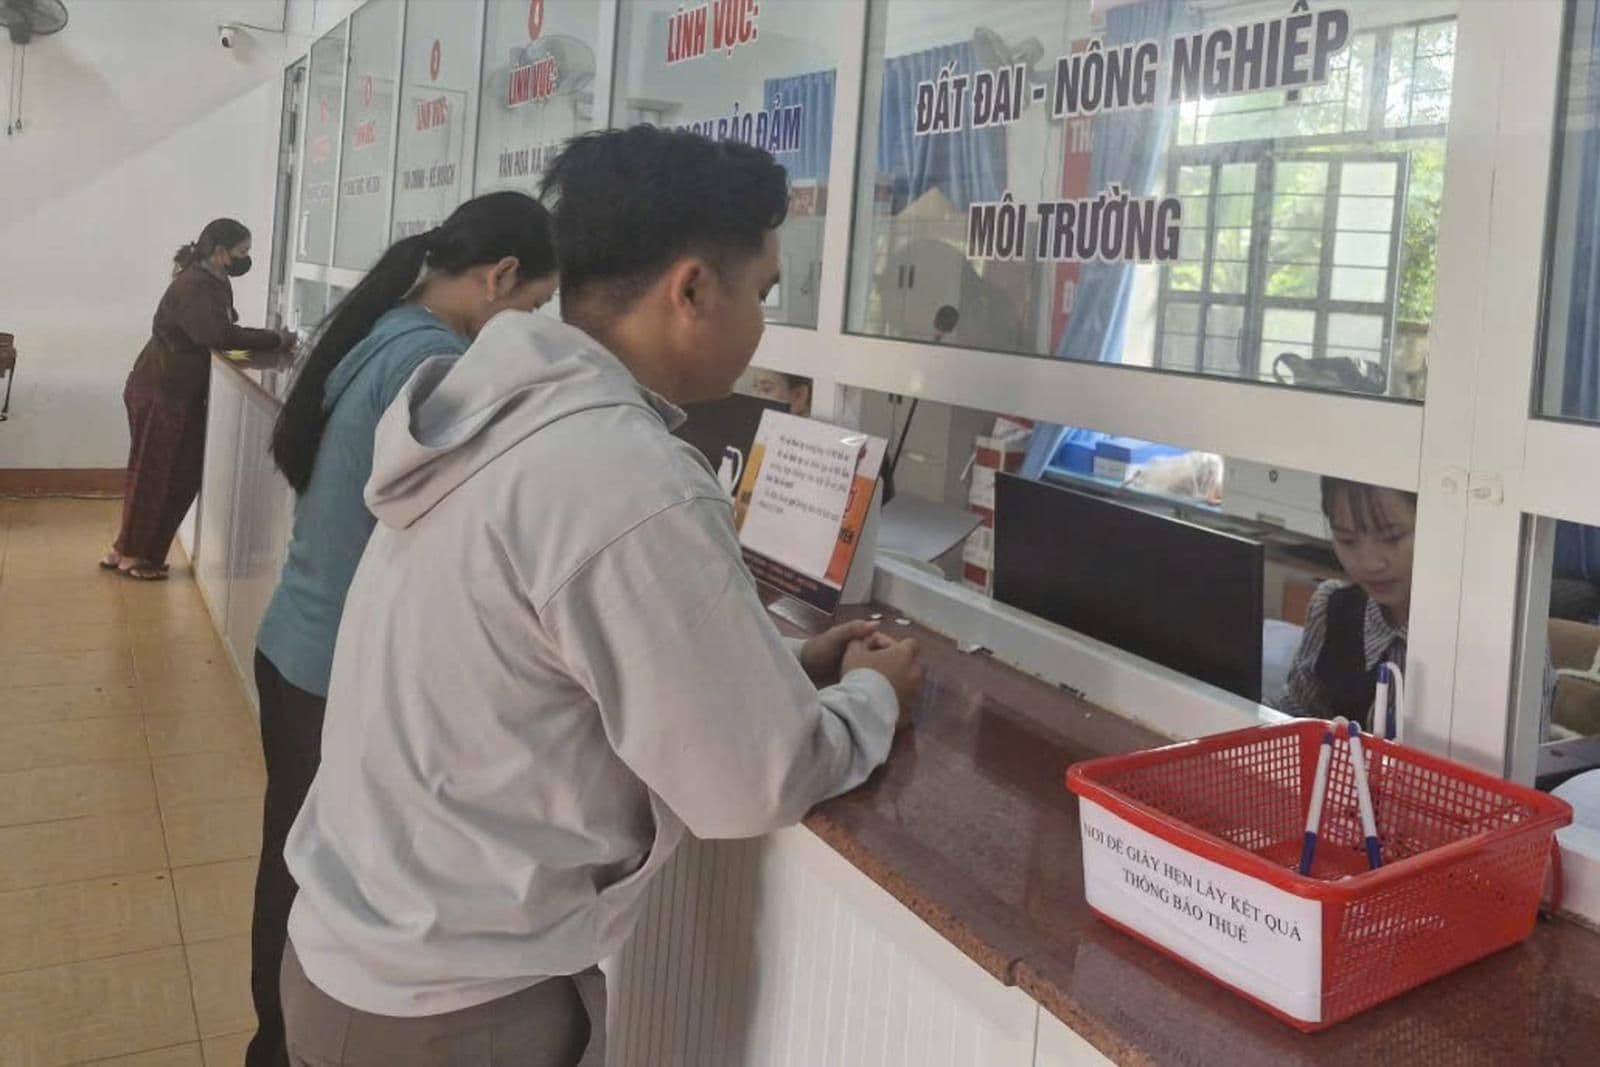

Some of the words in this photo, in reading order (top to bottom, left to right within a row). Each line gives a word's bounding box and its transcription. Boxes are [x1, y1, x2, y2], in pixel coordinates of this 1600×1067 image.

[916, 60, 966, 133] ĐẤT
[973, 66, 1024, 127] ĐAI
[1033, 87, 1045, 98] -
[1054, 39, 1158, 117] NÔNG
[1171, 1, 1349, 101] NGHIỆP
[969, 189, 1026, 260] MÔI
[1037, 186, 1182, 261] TRƯỜNG
[1122, 867, 1169, 904] THÔNG
[1173, 894, 1203, 921] BÁO
[1206, 911, 1248, 944] THUẾ
[1164, 862, 1192, 889] HẸN
[1197, 877, 1226, 904] LẤY
[1231, 895, 1261, 923] KẾT
[1265, 914, 1301, 942] QUẢ
